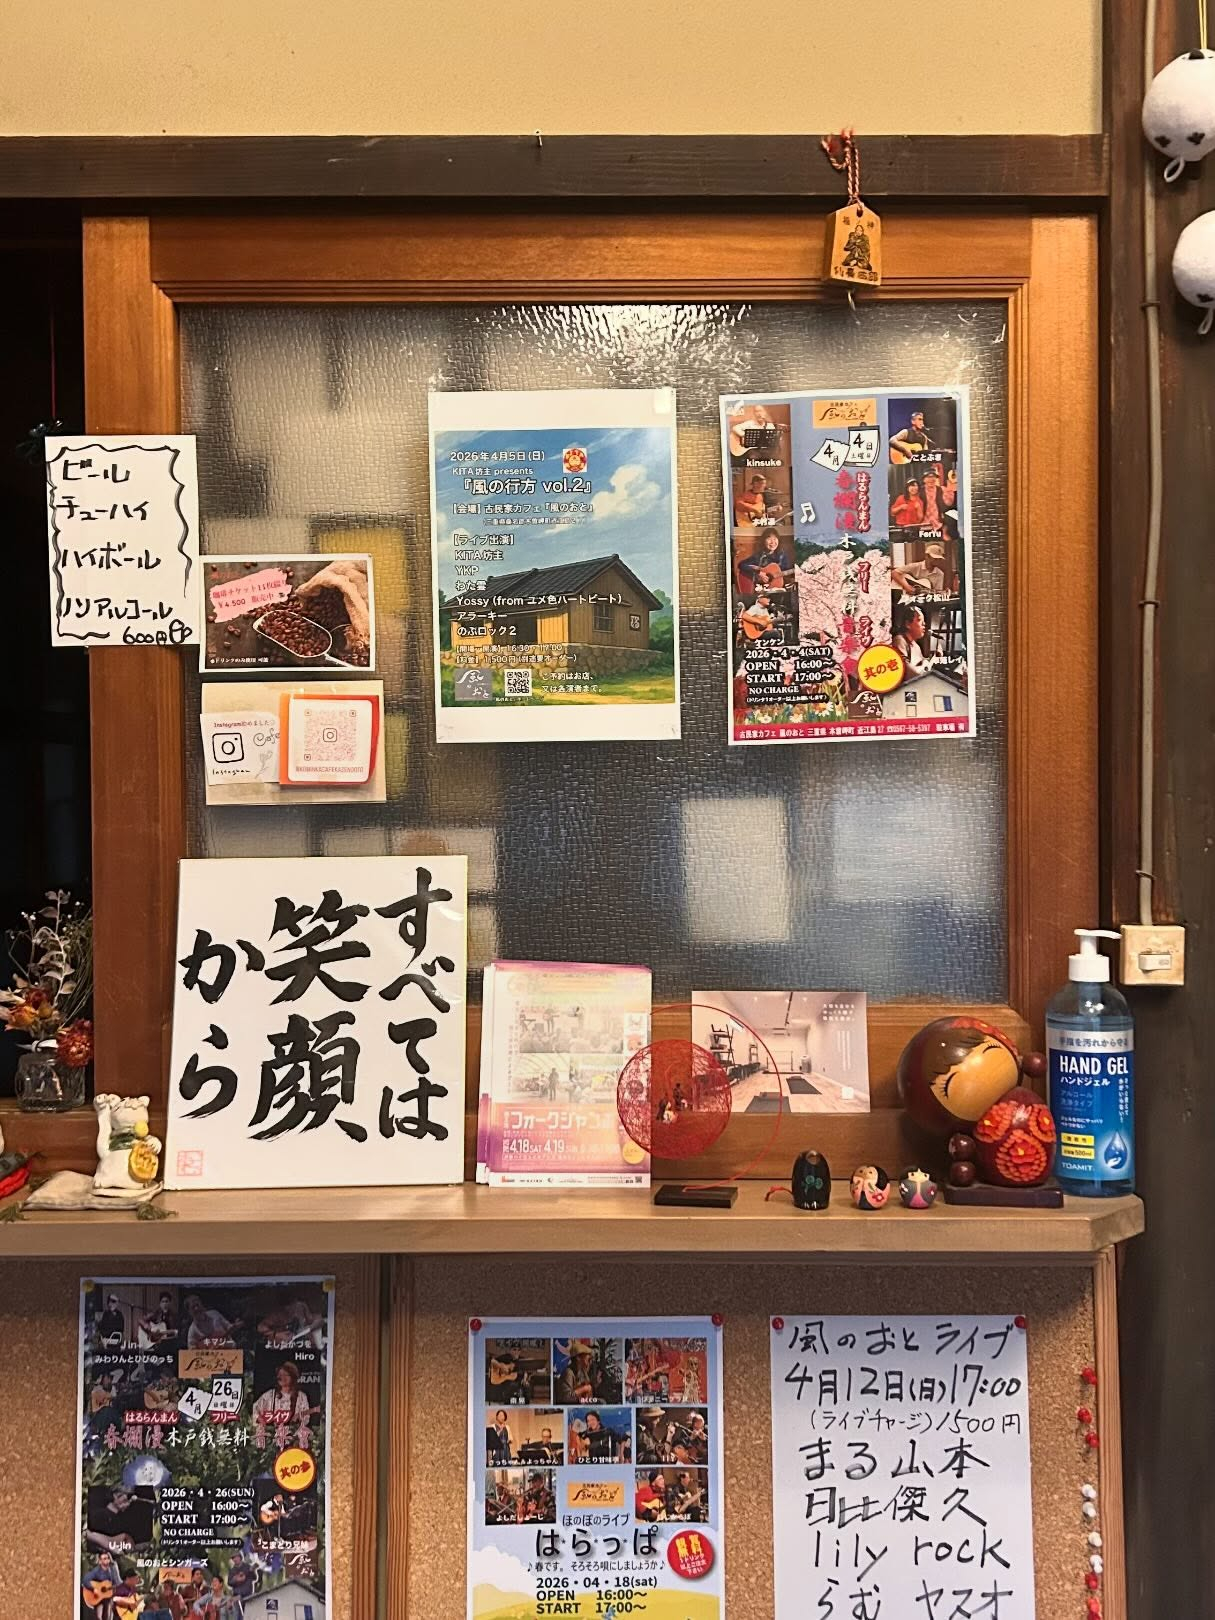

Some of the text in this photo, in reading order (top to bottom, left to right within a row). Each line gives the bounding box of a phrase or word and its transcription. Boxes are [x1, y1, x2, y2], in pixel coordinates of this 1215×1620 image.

[746, 458, 782, 467] kinsuke
[62, 458, 130, 483] ビール
[494, 468, 534, 476] presents
[56, 496, 150, 522] チューハイ
[61, 541, 162, 571] ハイボール
[455, 565, 480, 576] YKP
[858, 560, 872, 594] フリー
[456, 596, 490, 608] Yossy
[492, 595, 524, 608] (from
[61, 597, 174, 621] ノンアルコール
[456, 611, 508, 622] アラーキー
[122, 625, 168, 646] 600円
[746, 662, 778, 672] OPEN
[746, 673, 784, 684] START
[749, 685, 800, 695] NO CHARGE
[373, 866, 456, 1141] すべては
[246, 889, 372, 1143] 笑顔
[178, 928, 266, 1120] から
[1059, 1054, 1129, 1076] HAND GEL
[1060, 1076, 1111, 1087] ハンドジェル
[788, 1320, 1014, 1359] 風のおと ライブ
[294, 1352, 315, 1361] Hiro
[125, 1412, 178, 1423] はるらんまん
[211, 1413, 237, 1423] フリー
[264, 1412, 290, 1423] ライヴ
[162, 1501, 194, 1511] OPEN
[162, 1514, 198, 1524] START
[562, 1513, 630, 1527] ほのぼのライブ
[163, 1528, 214, 1536] NO CHARGE
[814, 1528, 1011, 1582] lily rock
[536, 1590, 575, 1601] OPEN
[536, 1602, 582, 1614] START
